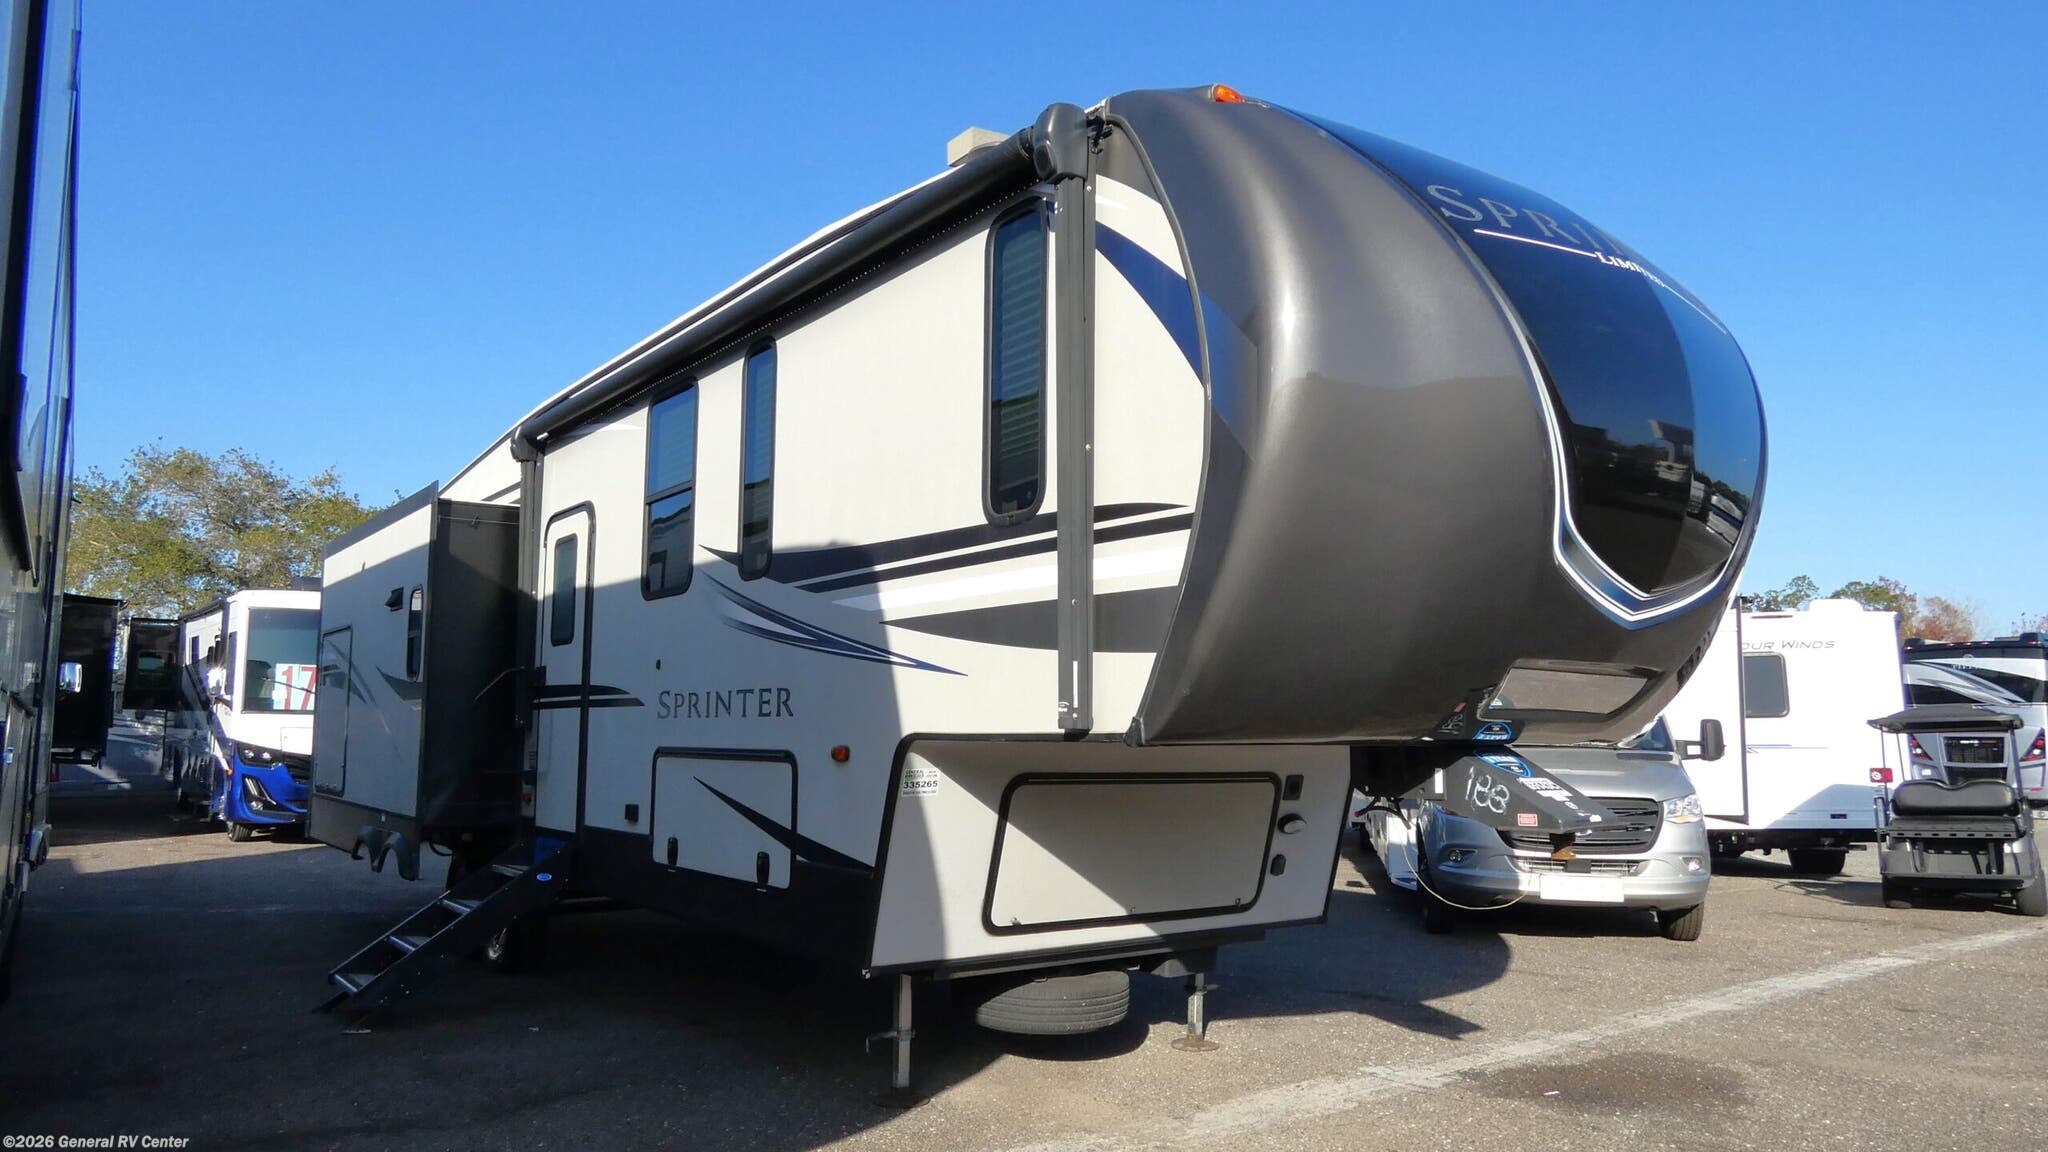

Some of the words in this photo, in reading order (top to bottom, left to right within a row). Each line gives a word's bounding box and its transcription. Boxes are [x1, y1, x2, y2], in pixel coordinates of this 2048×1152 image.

[1742, 642, 1775, 650] OUR
[1781, 640, 1836, 649] WINDS
[282, 666, 318, 711] 17
[657, 687, 794, 720] SPRINTER
[903, 780, 938, 789] 335265
